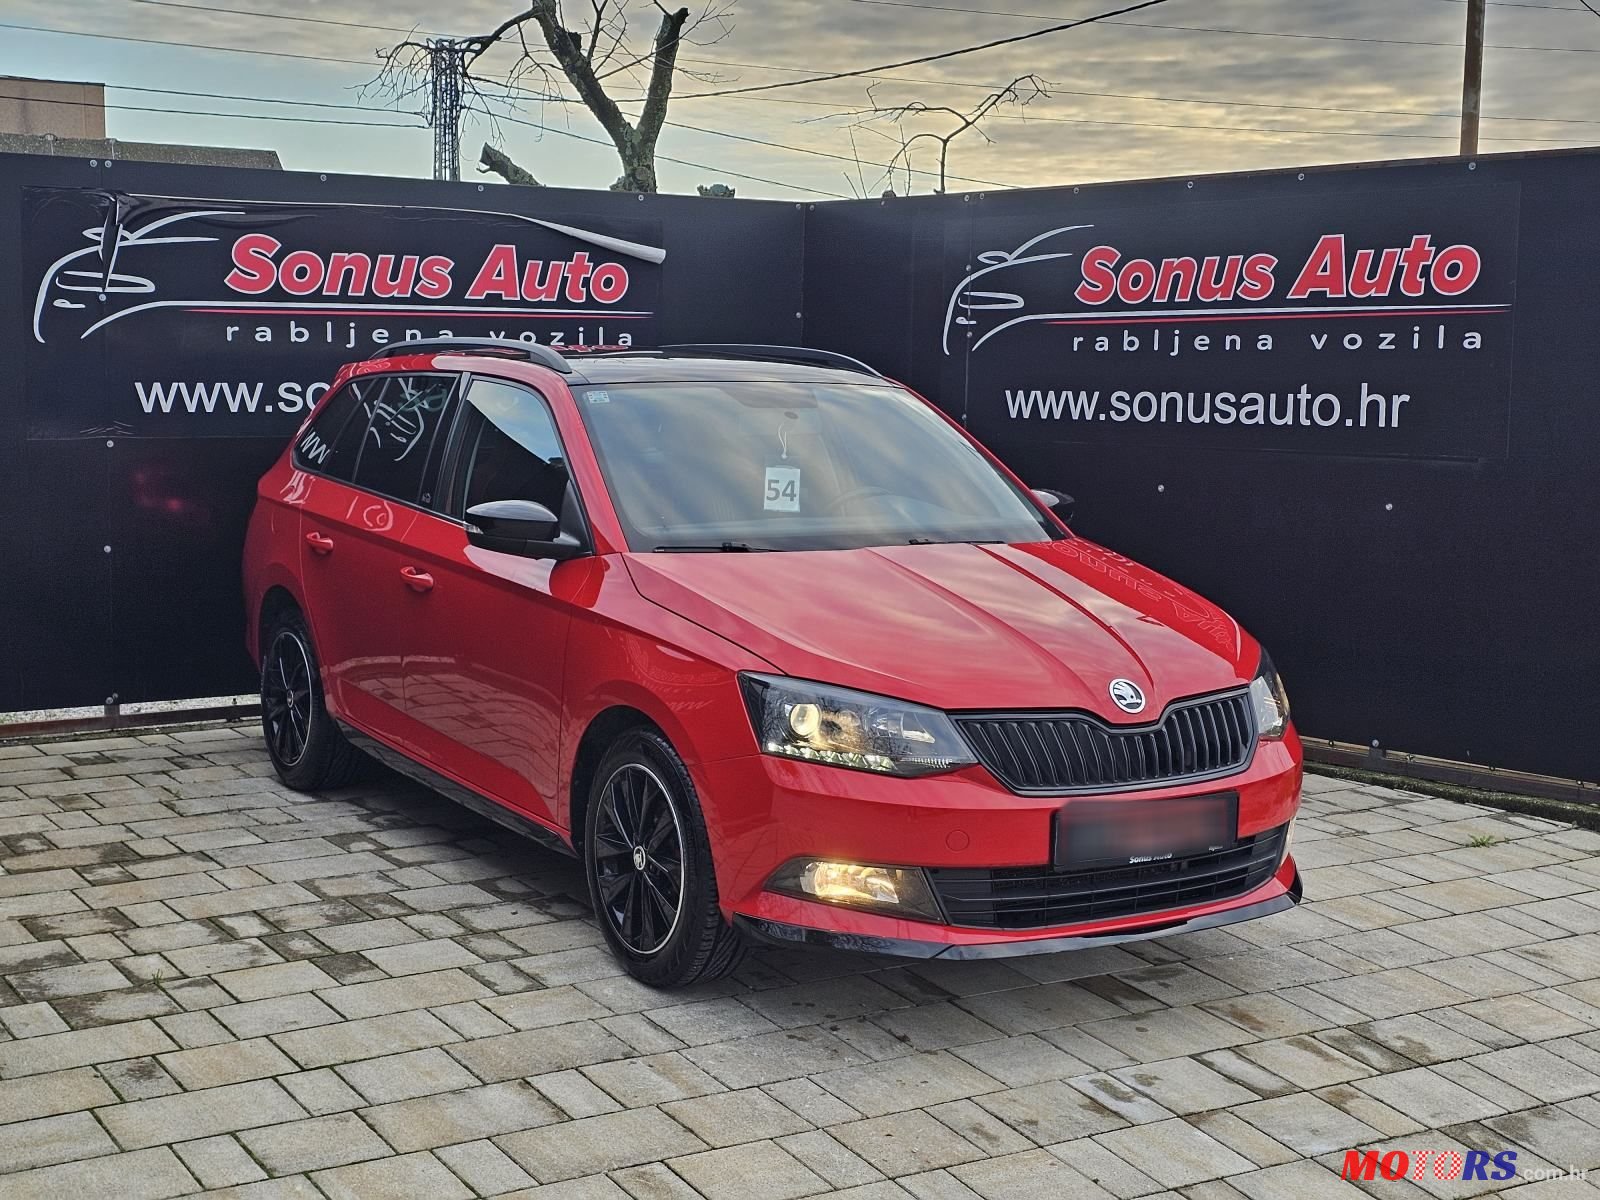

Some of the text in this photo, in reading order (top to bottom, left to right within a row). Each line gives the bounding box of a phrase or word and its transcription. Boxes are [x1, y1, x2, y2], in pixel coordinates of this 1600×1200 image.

[224, 234, 630, 303] Sonus Auto
[1074, 234, 1481, 305] Sonus Auto
[226, 321, 632, 349] rabljena vozila
[1073, 325, 1482, 357] rabljena vozila
[1005, 383, 1411, 428] www.sonusauto.hr
[765, 480, 797, 502] 54
